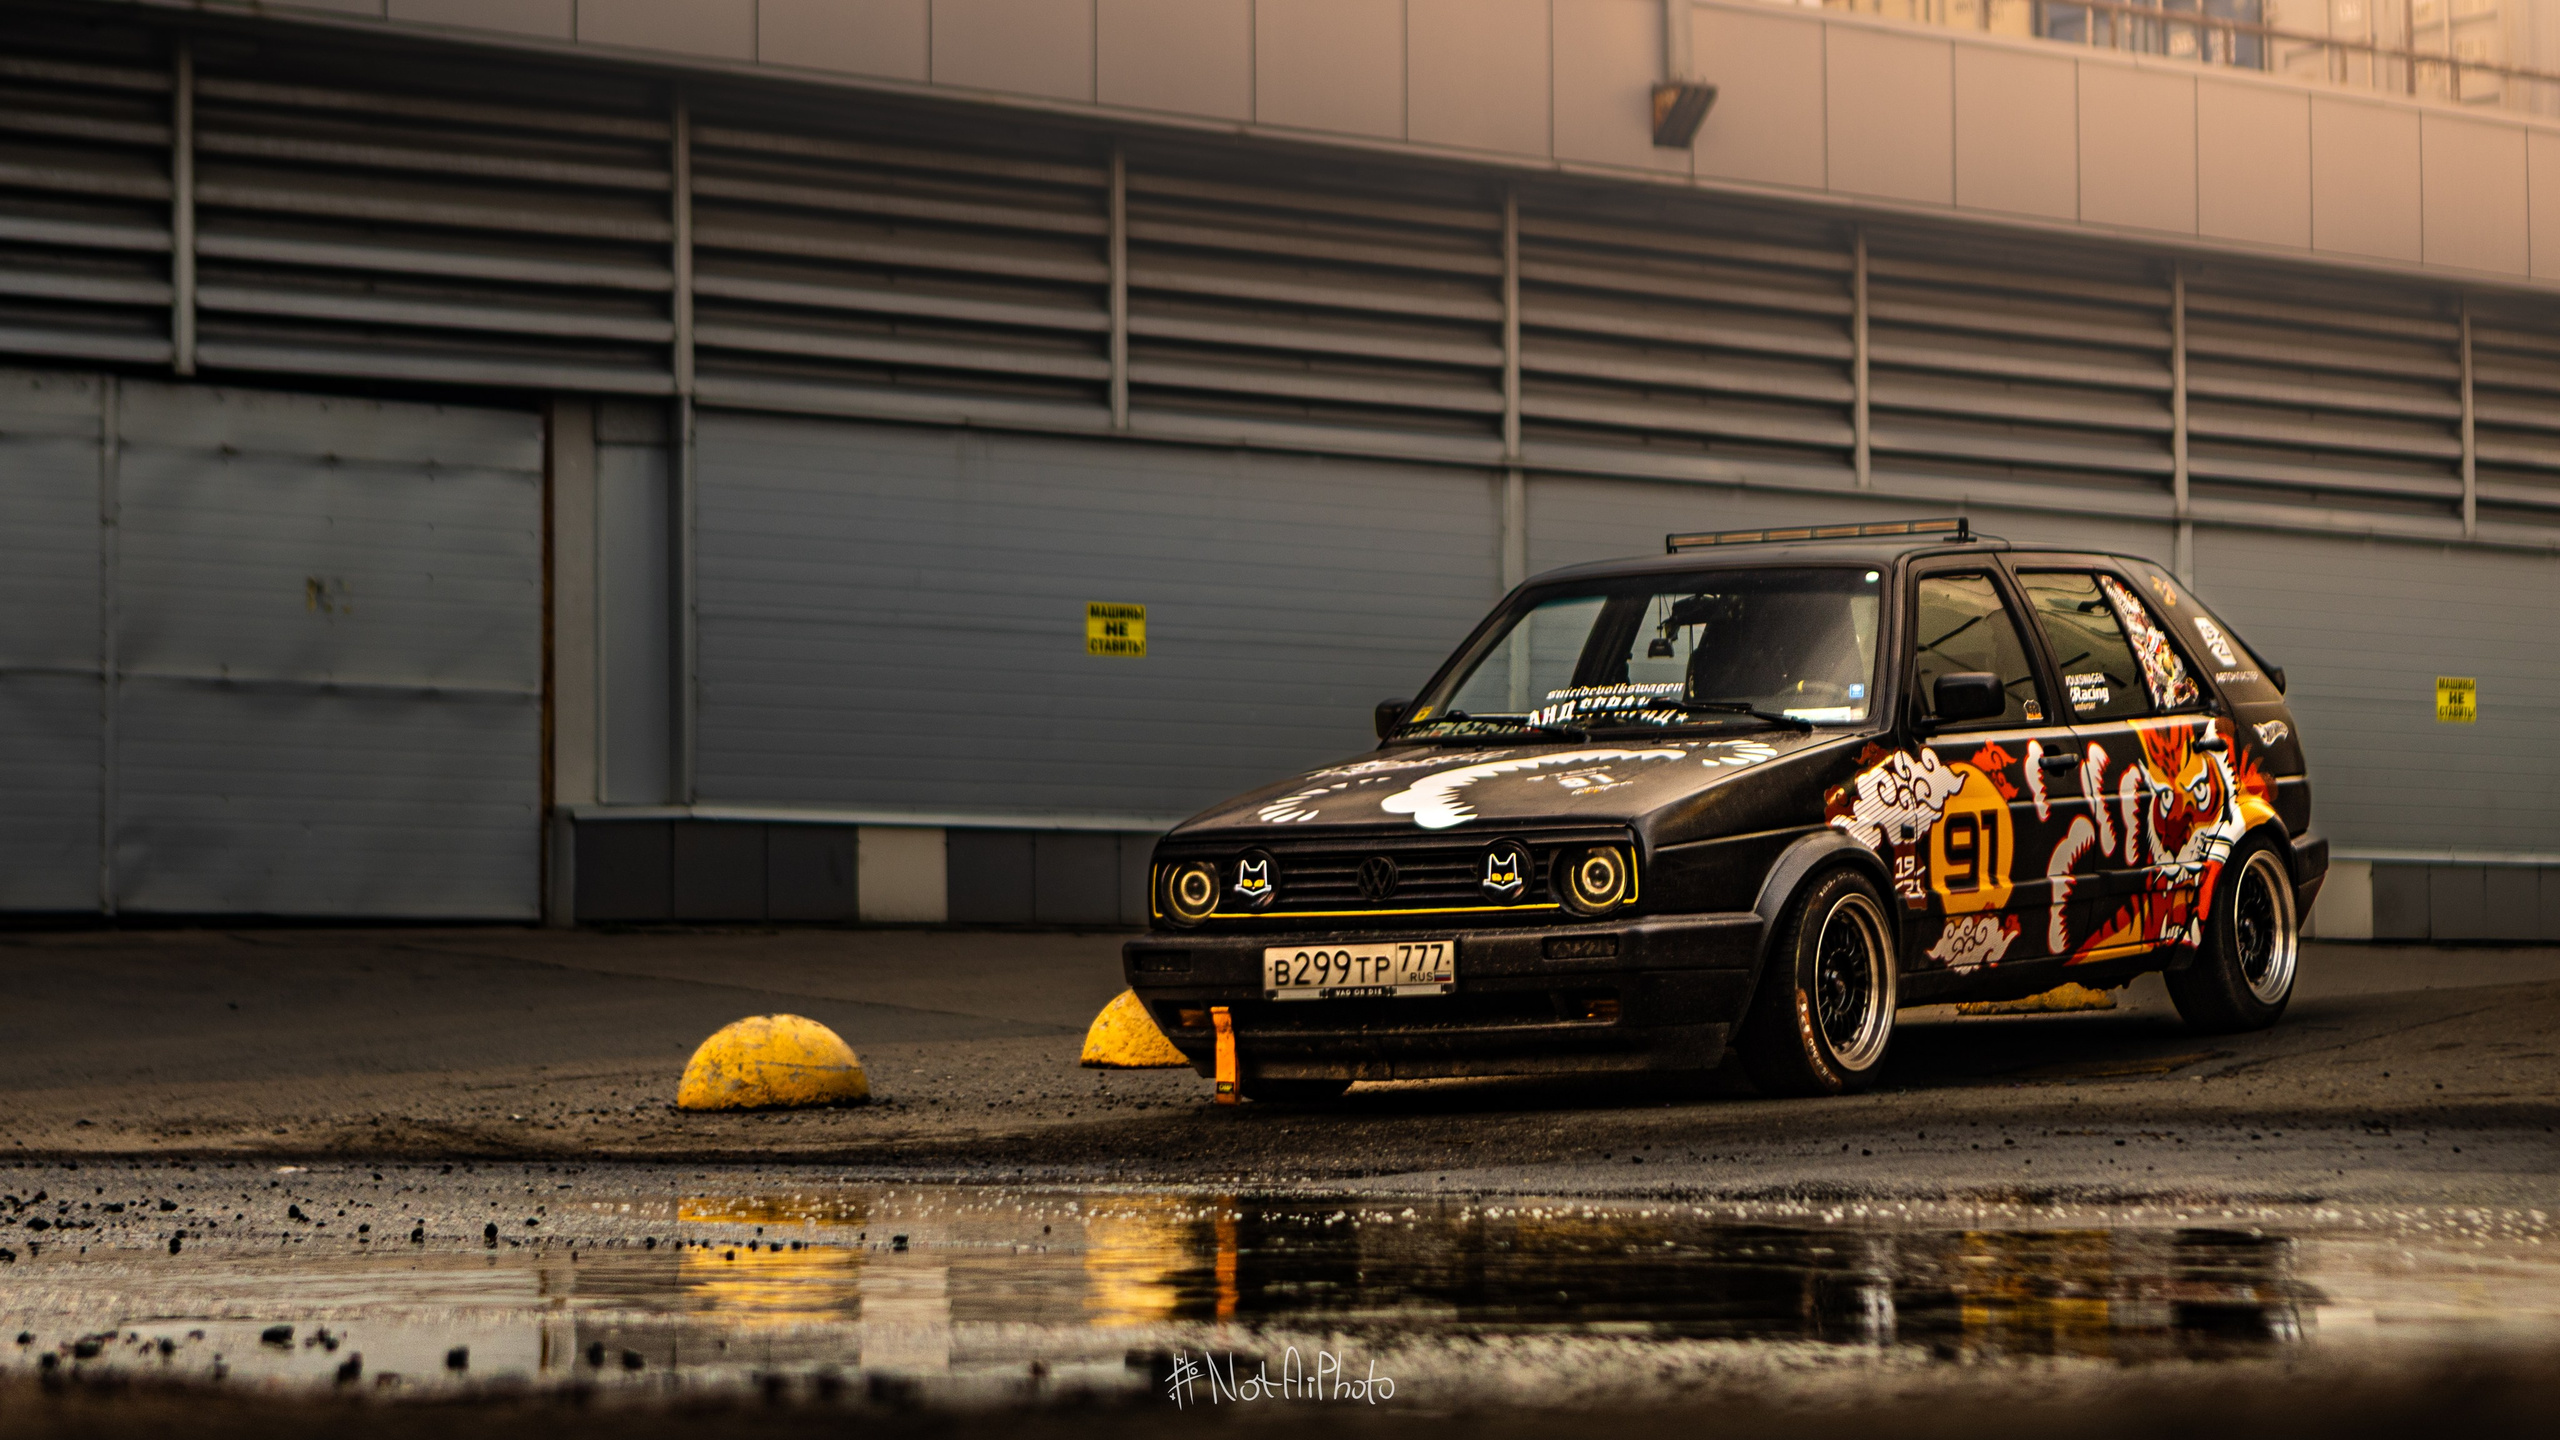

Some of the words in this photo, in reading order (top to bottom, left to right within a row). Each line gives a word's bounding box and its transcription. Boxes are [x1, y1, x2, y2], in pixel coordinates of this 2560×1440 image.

[1089, 604, 1145, 620] МАШИНЫ
[1105, 621, 1129, 637] НЕ
[2448, 690, 2466, 705] НЕ
[1943, 808, 1999, 895] 91
[1274, 949, 1391, 986] В299ТР
[1399, 944, 1444, 972] 777
[1410, 971, 1434, 982] RUS
